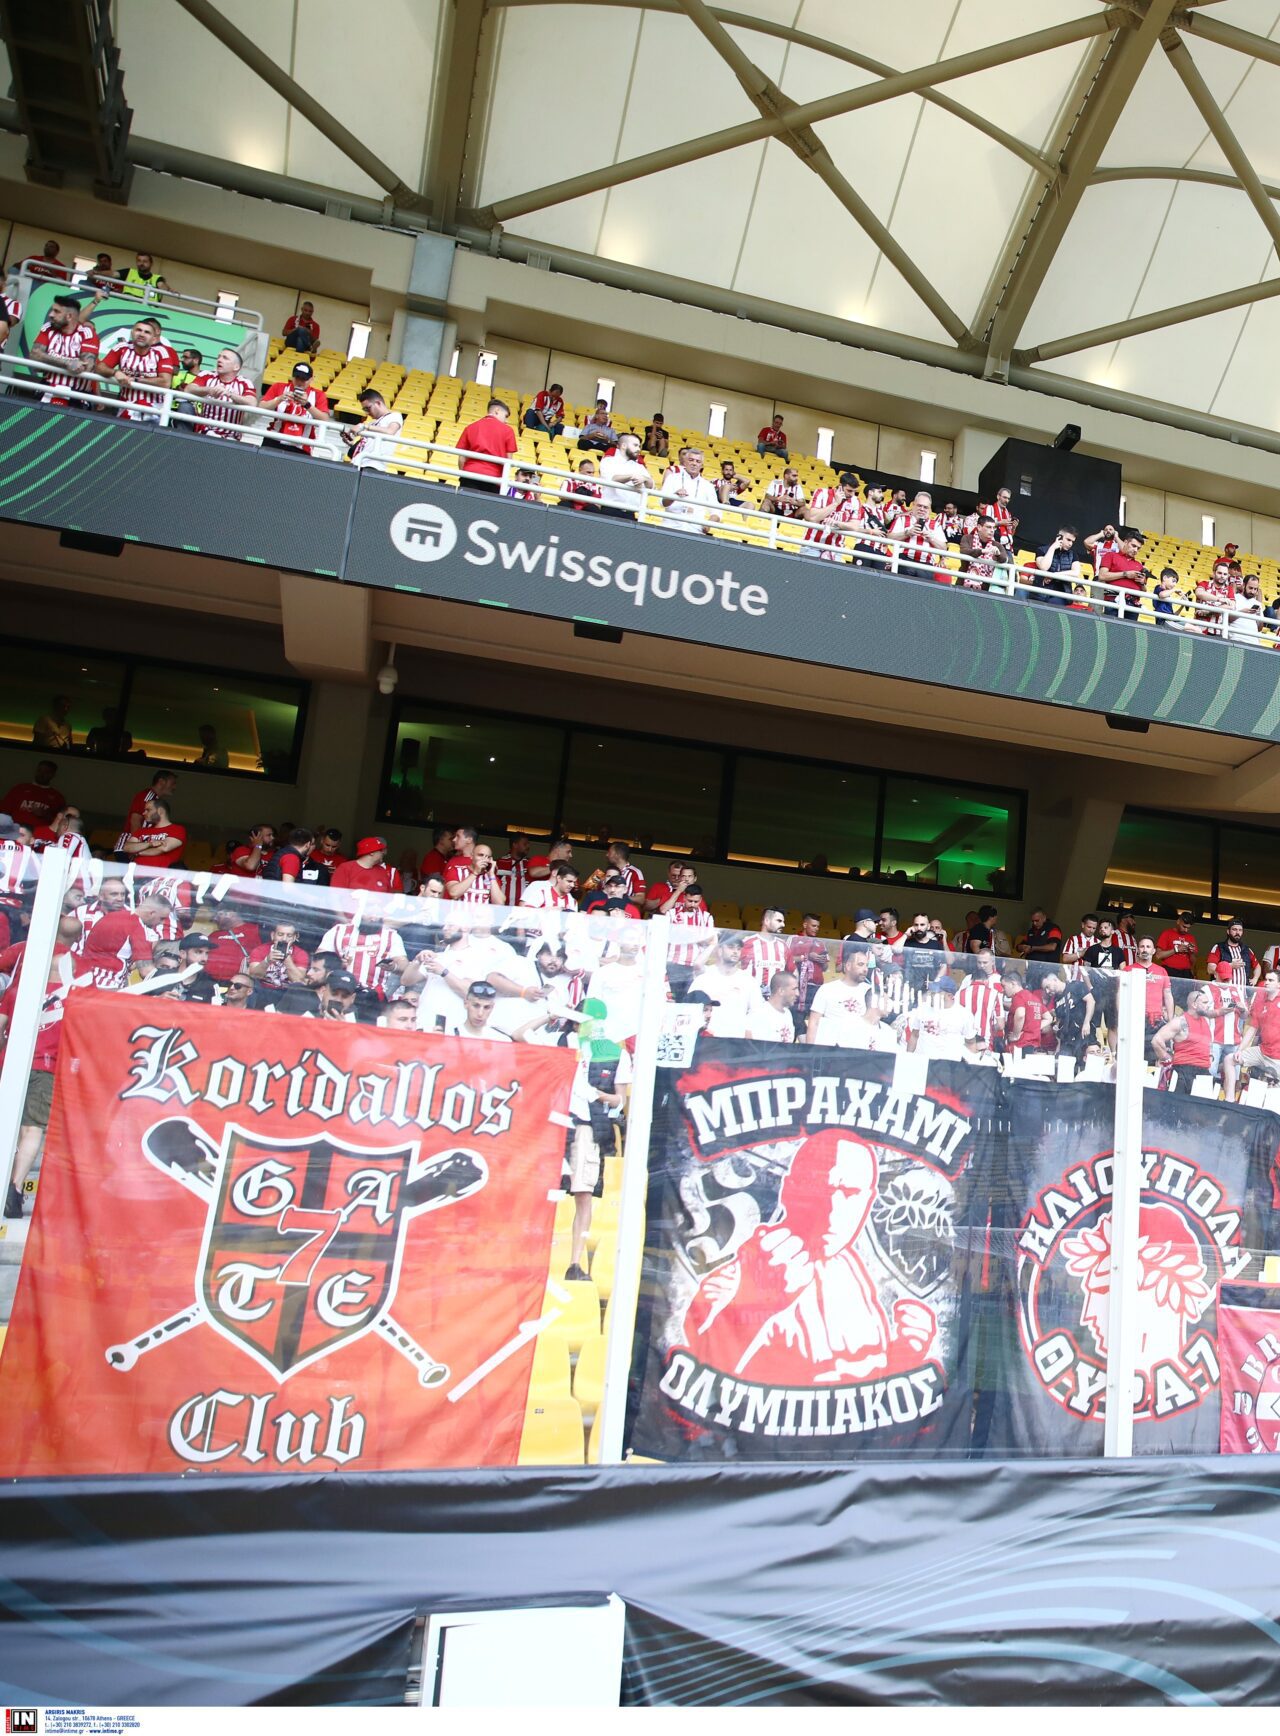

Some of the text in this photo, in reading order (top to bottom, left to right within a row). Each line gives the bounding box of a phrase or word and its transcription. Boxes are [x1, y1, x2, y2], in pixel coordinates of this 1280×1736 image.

[463, 518, 769, 616] Swissquote
[121, 1025, 520, 1137] Koridallos
[685, 1076, 972, 1166] ΜΠΡΑΧΑΜΙ
[168, 1389, 367, 1466] Club
[659, 1354, 944, 1437] ΟΛΥΜΠΙΑΚΟΣ
